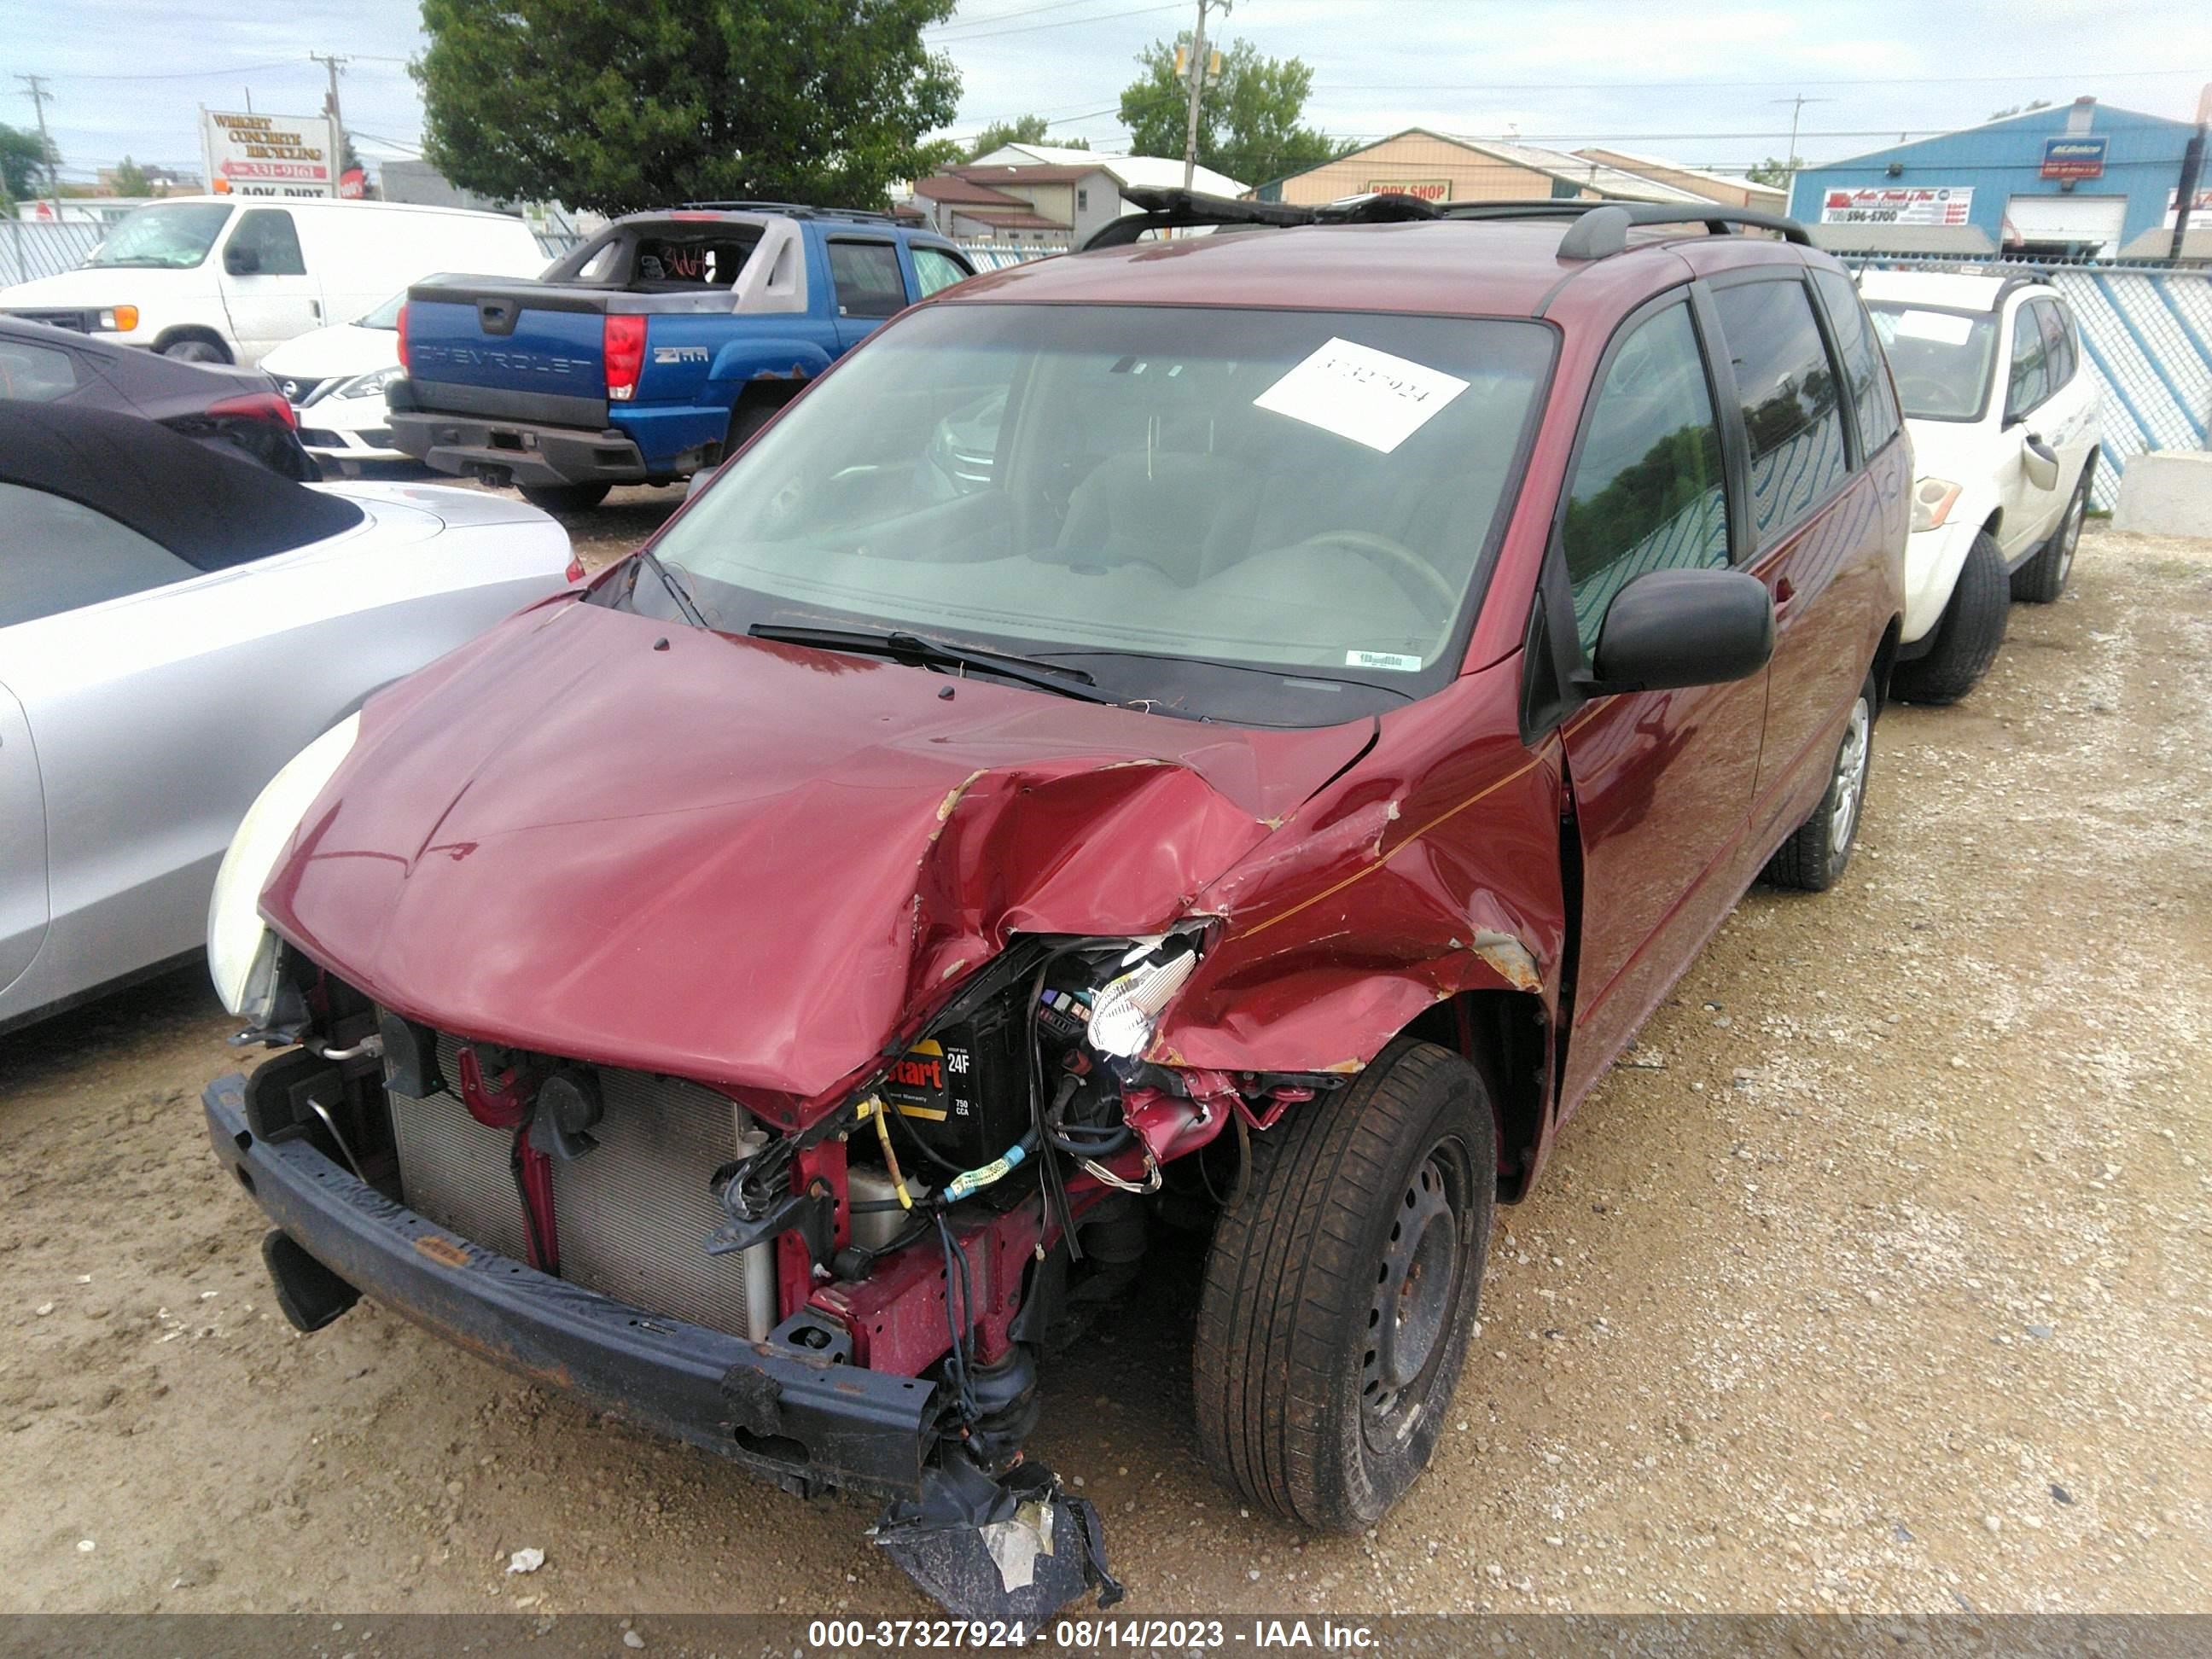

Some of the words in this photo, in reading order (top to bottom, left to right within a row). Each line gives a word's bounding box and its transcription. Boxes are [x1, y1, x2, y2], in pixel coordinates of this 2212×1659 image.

[213, 114, 272, 130] WRIGHT
[229, 130, 301, 146] CONCRETE
[246, 145, 322, 160] RECYCLING
[1410, 184, 1446, 199] SHOP
[416, 344, 592, 373] CHEVROLET
[947, 1053, 969, 1074] 24F
[956, 1098, 969, 1109] 750
[956, 1107, 969, 1116] CCA
